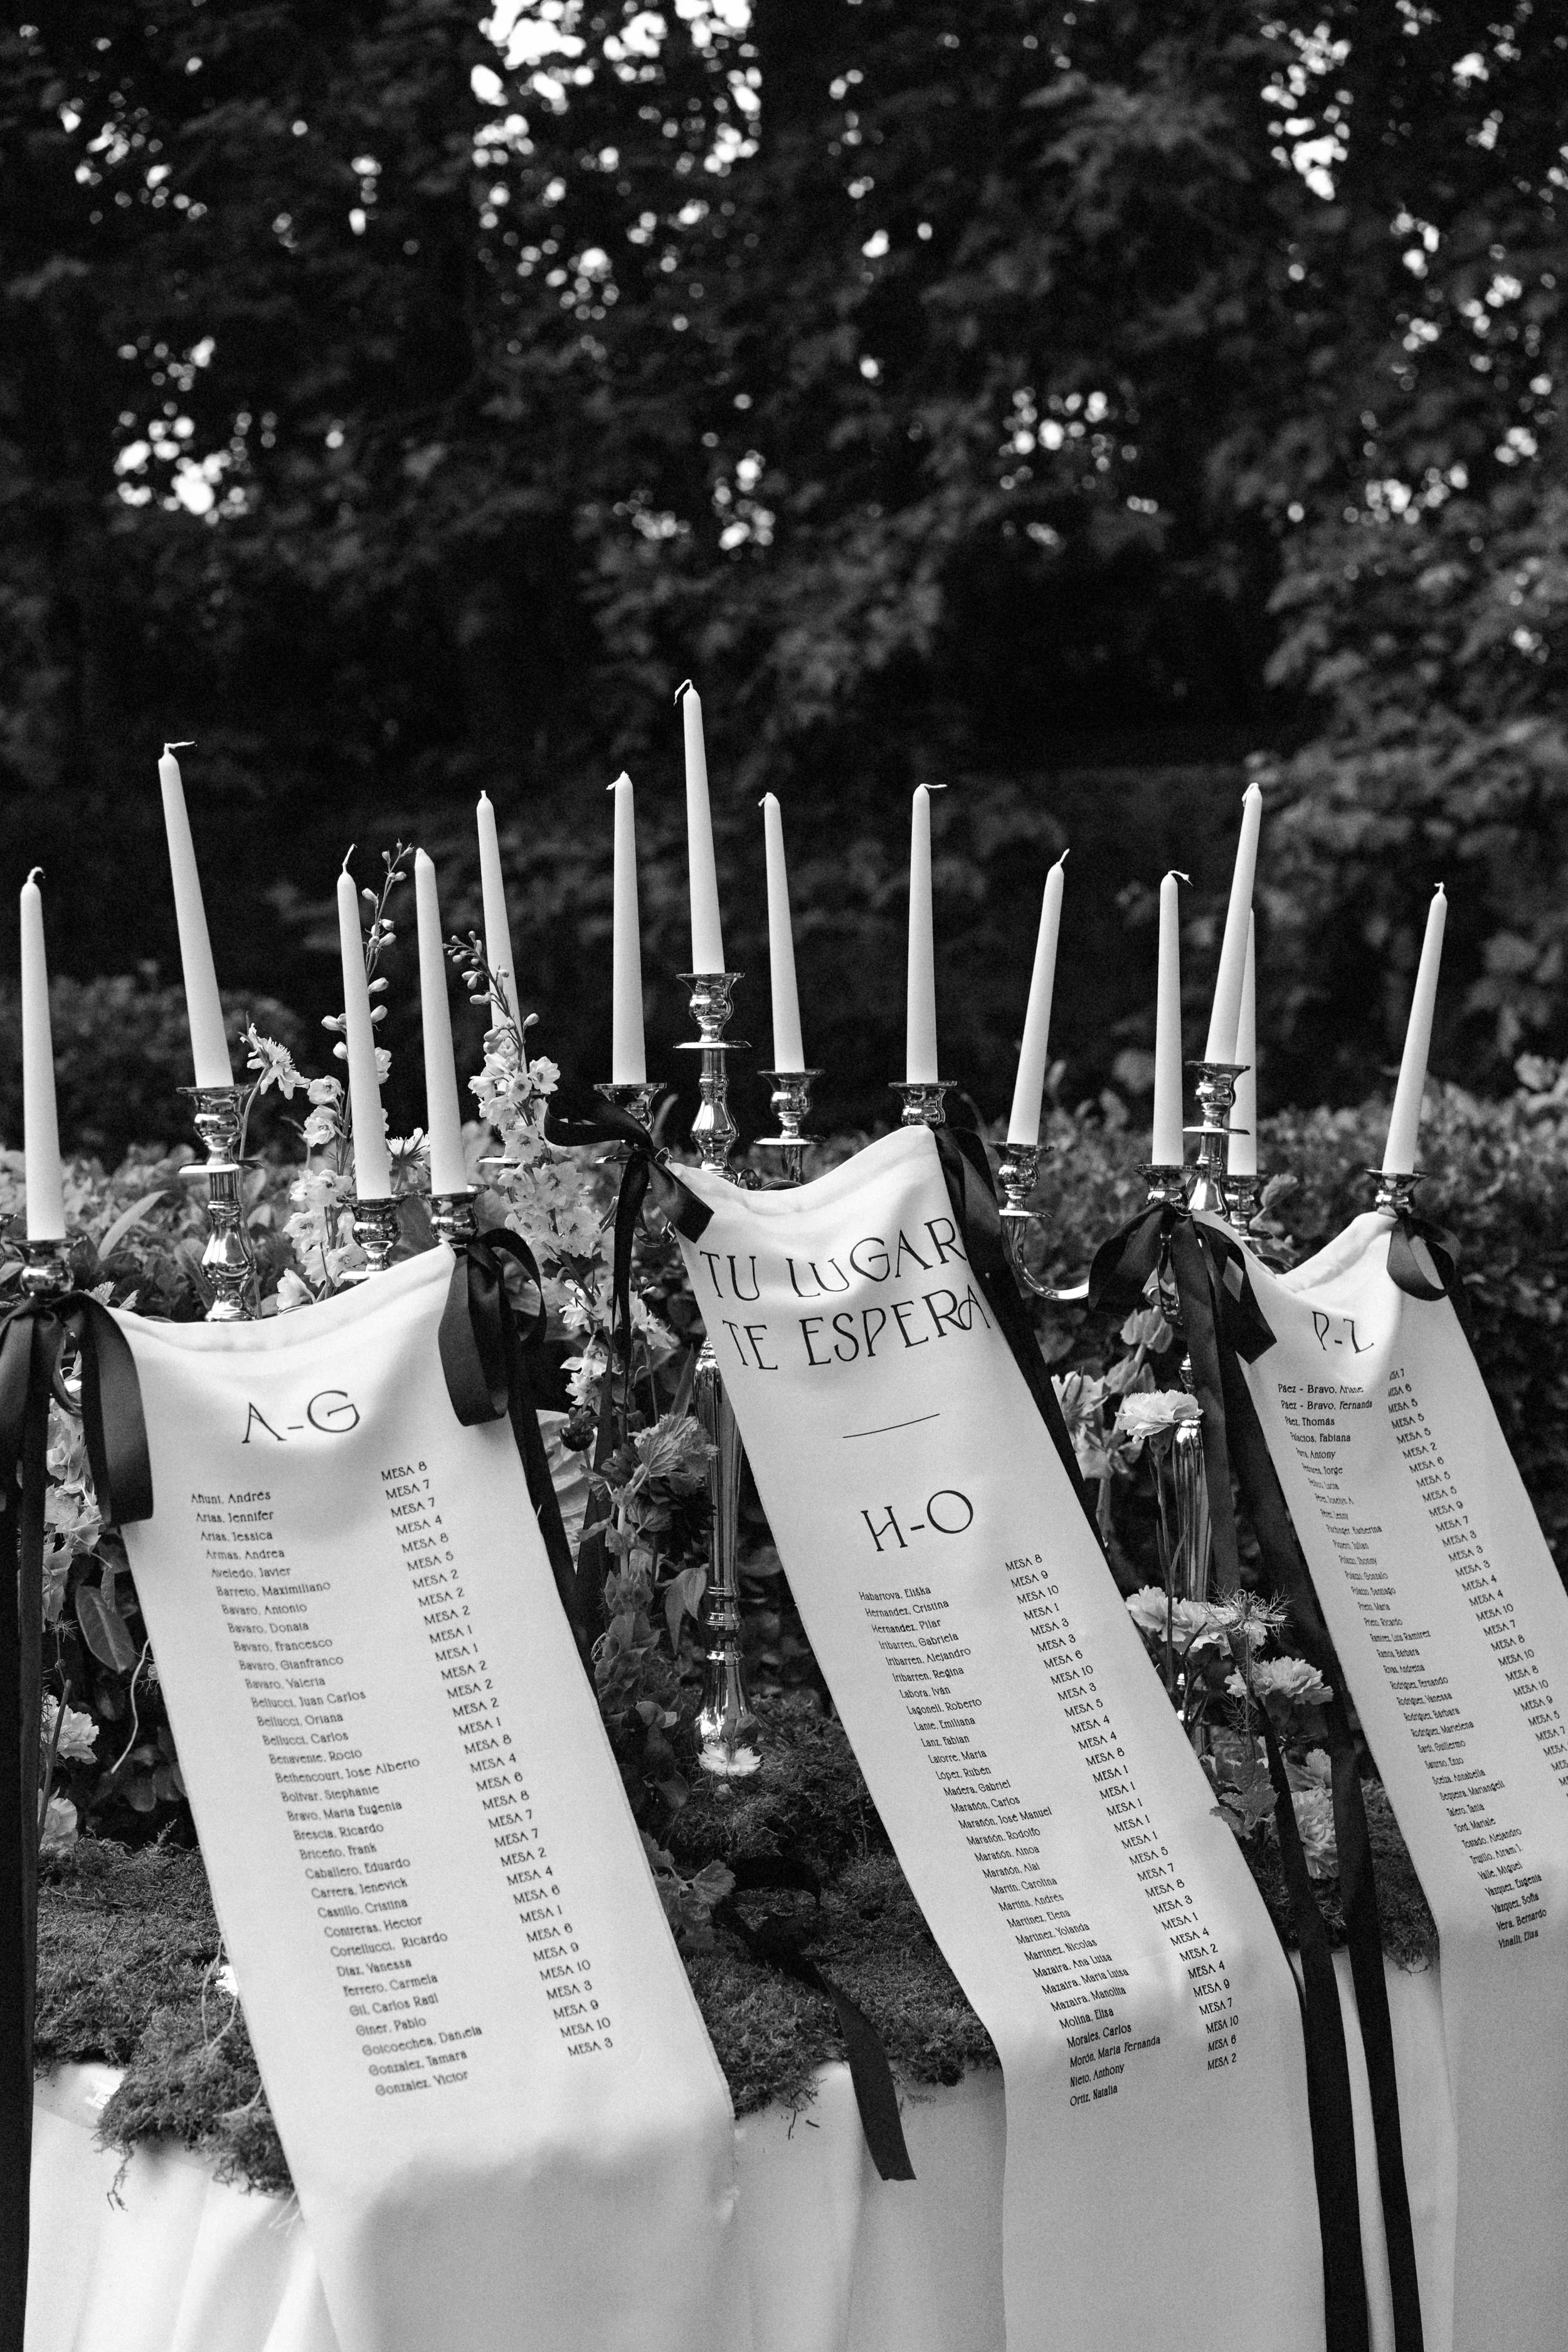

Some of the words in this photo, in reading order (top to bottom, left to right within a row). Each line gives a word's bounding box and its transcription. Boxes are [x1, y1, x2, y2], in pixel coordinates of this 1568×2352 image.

[699, 1251, 760, 1301] TU
[786, 1217, 967, 1298] LUGAR
[723, 1320, 778, 1370] TE
[799, 1285, 991, 1366] ESPERA
[1312, 1311, 1375, 1353] P-Z
[242, 1390, 361, 1443] A-G
[1391, 1416, 1416, 1429] MESA
[1417, 1412, 1425, 1422] 5
[1402, 1445, 1429, 1459] MESA
[1429, 1441, 1438, 1451] 2
[380, 1465, 415, 1481] MESA
[418, 1461, 428, 1471] 8
[1409, 1459, 1436, 1473] MESA
[1436, 1456, 1444, 1465] 6
[385, 1483, 421, 1500] MESA
[422, 1478, 430, 1490] 7
[228, 1510, 274, 1523] Jennifer
[1428, 1503, 1455, 1517] MESA
[1456, 1500, 1464, 1509] 9
[395, 1518, 431, 1535] MESA
[435, 1514, 442, 1525] 4
[861, 1490, 973, 1552] H-O
[1435, 1518, 1462, 1532] MESA
[1462, 1515, 1469, 1525] 7
[401, 1537, 437, 1554] MESA
[440, 1532, 449, 1544] 8
[245, 1549, 285, 1560] Andrea
[406, 1555, 442, 1571] MESA
[445, 1550, 454, 1561] 5
[1005, 1557, 1033, 1571] MESA
[1034, 1554, 1043, 1564] 8
[1448, 1549, 1475, 1562] MESA
[1476, 1545, 1483, 1554] 3
[412, 1573, 448, 1589] MESA
[450, 1569, 459, 1580] 2
[1010, 1573, 1040, 1588] MESA
[1041, 1570, 1049, 1579] 9
[261, 1582, 331, 1596] Maximiliano
[1016, 1589, 1046, 1604] MESA
[1047, 1584, 1059, 1596] 10
[1468, 1592, 1496, 1607] MESA
[1497, 1589, 1504, 1598] 4
[423, 1609, 459, 1626] MESA
[462, 1605, 470, 1616] 2
[912, 1601, 950, 1614] Cristina
[1475, 1608, 1502, 1622] MESA
[1502, 1603, 1514, 1614] 10
[1029, 1621, 1060, 1636] MESA
[1061, 1618, 1069, 1628] 3
[1490, 1637, 1517, 1651] MESA
[1517, 1634, 1525, 1644] 8
[926, 1648, 972, 1663] Alejandro
[1043, 1653, 1074, 1669] MESA
[1074, 1650, 1083, 1660] 6
[1050, 1670, 1081, 1685] MESA
[1081, 1665, 1094, 1676] 10
[446, 1682, 482, 1699] MESA
[484, 1678, 494, 1690] 2
[944, 1698, 982, 1711] Roberto
[1063, 1702, 1094, 1717] MESA
[1096, 1698, 1103, 1708] 5
[1520, 1698, 1546, 1712] MESA
[1545, 1695, 1554, 1704] 9
[304, 1714, 344, 1725] Oriana
[1071, 1719, 1101, 1734] MESA
[1103, 1715, 1110, 1724] 4
[464, 1738, 500, 1754] MESA
[502, 1734, 512, 1745] 8
[942, 1735, 970, 1745] Fabian
[469, 1757, 506, 1773] MESA
[509, 1752, 517, 1763] 4
[1085, 1751, 1115, 1766] MESA
[1116, 1747, 1125, 1757] 8
[345, 1767, 371, 1779] Jose
[376, 1758, 420, 1775] Alberto
[475, 1775, 511, 1792] MESA
[514, 1771, 523, 1783] 6
[990, 1797, 1020, 1808] Carlos
[487, 1812, 523, 1829] MESA
[525, 1808, 532, 1820] 7
[1019, 1806, 1052, 1821] Manuel
[338, 1823, 384, 1838] Ricardo
[1128, 1850, 1159, 1865] MESA
[1160, 1846, 1168, 1856] 5
[364, 1858, 411, 1873] Eduardo
[1136, 1866, 1167, 1882] MESA
[1167, 1862, 1174, 1872] 7
[1020, 1878, 1058, 1890] Carolina
[1144, 1882, 1175, 1898] MESA
[1176, 1878, 1185, 1888] 8
[512, 1888, 549, 1905] MESA
[551, 1884, 561, 1895] 6
[1054, 1923, 1090, 1936] Yolanda
[532, 1945, 568, 1962] MESA
[569, 1942, 580, 1952] 9
[1072, 1958, 1090, 1969] Ana
[1089, 1954, 1113, 1964] Luisa
[1179, 1946, 1209, 1961] MESA
[1210, 1943, 1219, 1954] 2
[539, 1964, 575, 1981] MESA
[577, 1959, 591, 1972] 10
[546, 1983, 581, 2000] MESA
[583, 1979, 593, 1991] 3
[372, 2000, 411, 2014] Carlos
[1199, 2000, 1227, 2016] MESA
[1227, 1996, 1232, 2008] 7
[1102, 2024, 1132, 2038] Carlos
[1096, 2045, 1121, 2060] Maria
[1124, 2035, 1161, 2053] Fernanda
[425, 2050, 468, 2067] Tamara
[1093, 2063, 1125, 2080] Anthony
[1093, 2085, 1118, 2100] Natalia
